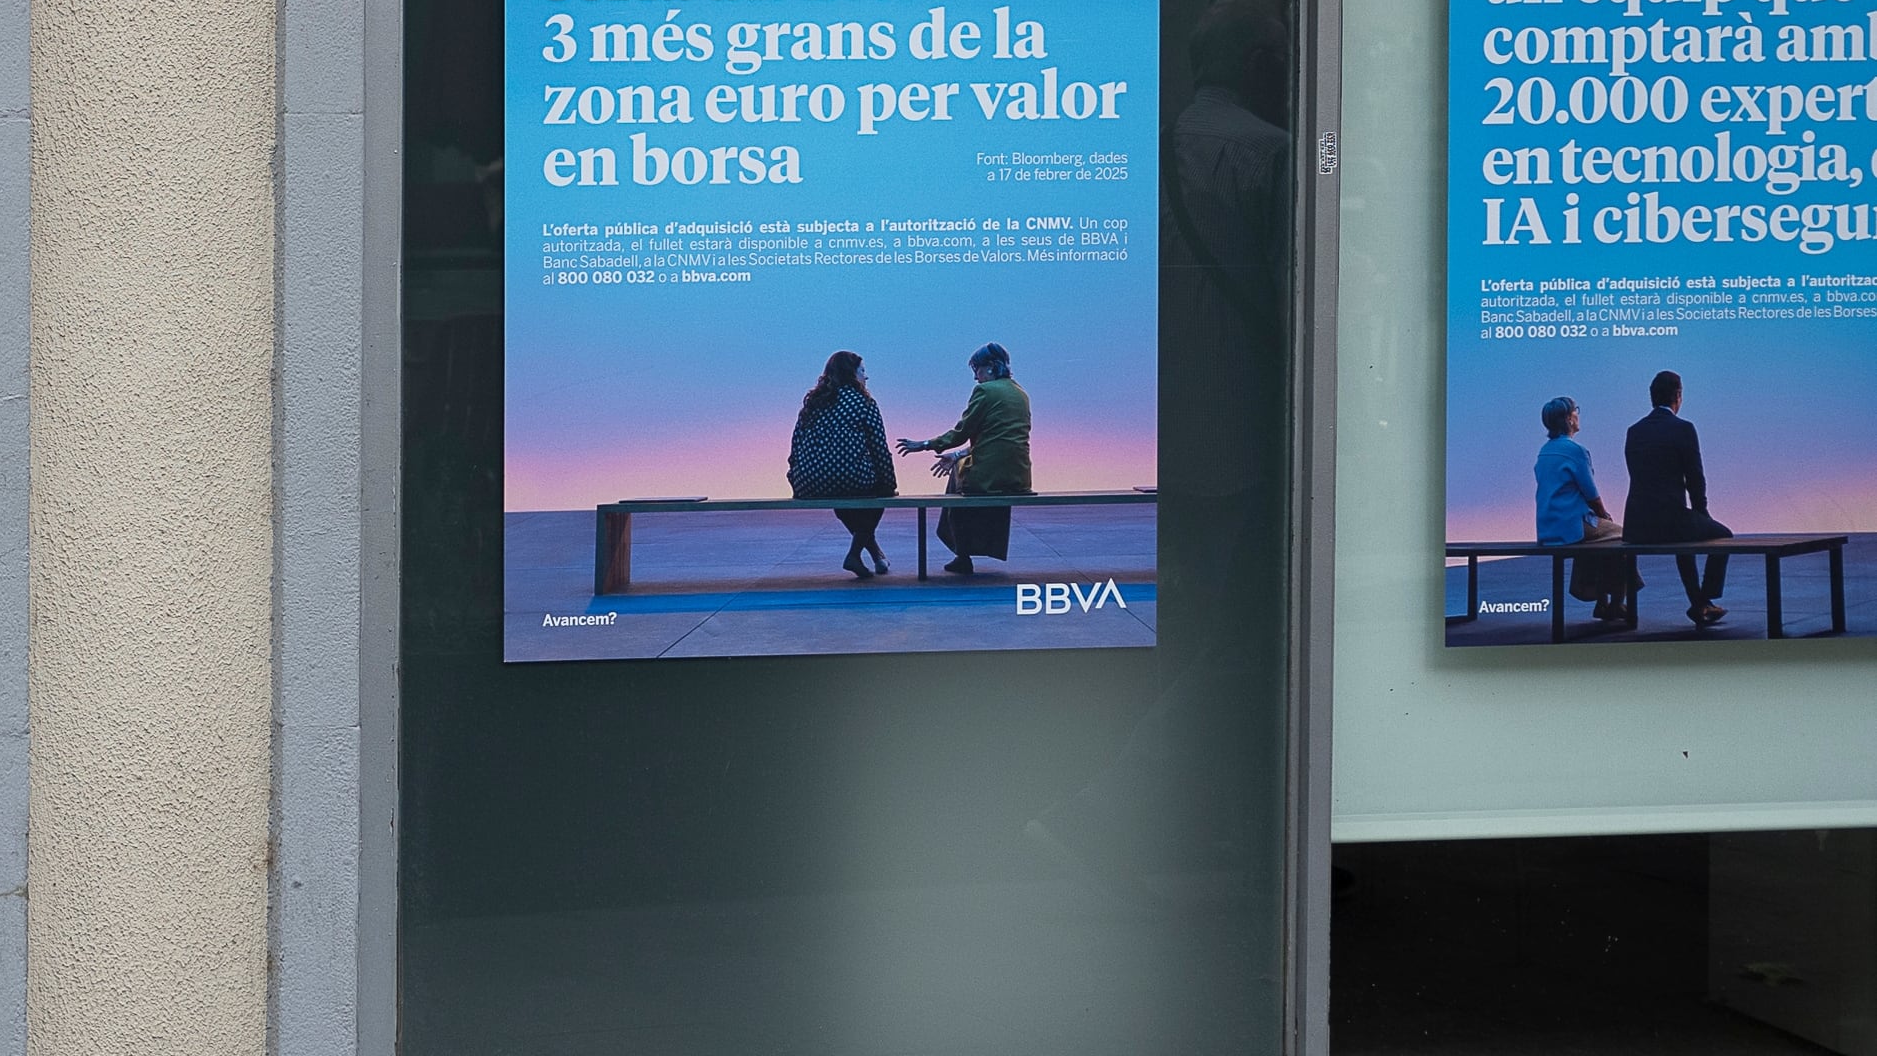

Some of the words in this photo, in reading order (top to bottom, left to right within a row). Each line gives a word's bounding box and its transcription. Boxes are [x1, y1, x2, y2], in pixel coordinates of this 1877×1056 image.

[542, 13, 577, 63] 3
[589, 8, 715, 62] més
[725, 21, 897, 74] grans
[908, 6, 982, 60] de
[992, 5, 1048, 60] la
[1483, 11, 1767, 77] comptarà
[543, 84, 695, 126] zona
[704, 81, 846, 124] euro
[856, 82, 960, 135] per
[969, 66, 1128, 121] valor
[1481, 75, 1689, 125] 20.000
[543, 147, 620, 187] en
[628, 133, 804, 186] borsa
[976, 152, 1009, 166] Font:
[1011, 151, 1086, 167] Bloomberg,
[1088, 151, 1129, 165] dades
[1482, 146, 1554, 186] en
[1559, 129, 1864, 197] tecnologia,
[986, 171, 996, 182] a
[998, 167, 1012, 182] 17
[1014, 167, 1032, 182] de
[1033, 167, 1073, 181] febrer
[1075, 165, 1092, 181] de
[1094, 166, 1129, 181] 2025
[604, 221, 659, 237] pública
[758, 220, 791, 234] està
[796, 219, 860, 235] subjecta
[865, 222, 875, 233] a
[982, 217, 1001, 231] de
[1006, 217, 1020, 231] la
[1025, 216, 1074, 231] CNMV.
[1079, 216, 1098, 230] Un
[1103, 219, 1128, 232] cop
[1482, 197, 1552, 246] IA
[1562, 192, 1583, 244] i
[542, 238, 625, 253] autoritzada,
[630, 238, 643, 252] el
[648, 237, 684, 251] fullet
[689, 235, 733, 251] estarà
[738, 236, 809, 253] disponible
[814, 238, 823, 249] a
[828, 237, 887, 249] cnmv.es,
[893, 237, 902, 248] a
[907, 234, 976, 248] bbva.com,
[981, 236, 991, 247] a
[996, 233, 1016, 247] les
[1020, 235, 1053, 246] seus
[1057, 232, 1075, 246] de
[1081, 231, 1119, 246] BBVA
[1124, 232, 1128, 245] i
[543, 255, 578, 269] Banc
[579, 254, 642, 269] Sabadell,
[643, 256, 652, 268] a
[653, 253, 665, 268] la
[666, 253, 712, 268] CNMV
[712, 253, 716, 266] i
[717, 255, 726, 267] a
[727, 252, 747, 266] les
[748, 250, 813, 266] Societats
[814, 251, 874, 265] Rectores
[875, 251, 893, 264] de
[893, 250, 913, 264] les
[914, 250, 962, 264] Borses
[962, 249, 980, 263] de
[980, 249, 1026, 263] Valors.
[1027, 248, 1055, 262] Més
[1056, 247, 1128, 262] informació
[542, 271, 555, 286] al
[557, 271, 589, 285] 800
[592, 270, 623, 284] 080
[626, 269, 655, 284] 032
[658, 273, 668, 283] o
[670, 272, 679, 283] a
[681, 269, 751, 283] bbva.com
[1480, 326, 1492, 339] al
[1494, 325, 1524, 339] 800
[1527, 324, 1557, 338] 080
[1559, 324, 1588, 338] 032
[1590, 327, 1599, 337] o
[1601, 327, 1610, 337] a
[1612, 324, 1679, 337] bbva.com
[1016, 577, 1127, 616] BBVA
[1478, 598, 1550, 614] Avancem?
[542, 611, 618, 627] Avancem?
